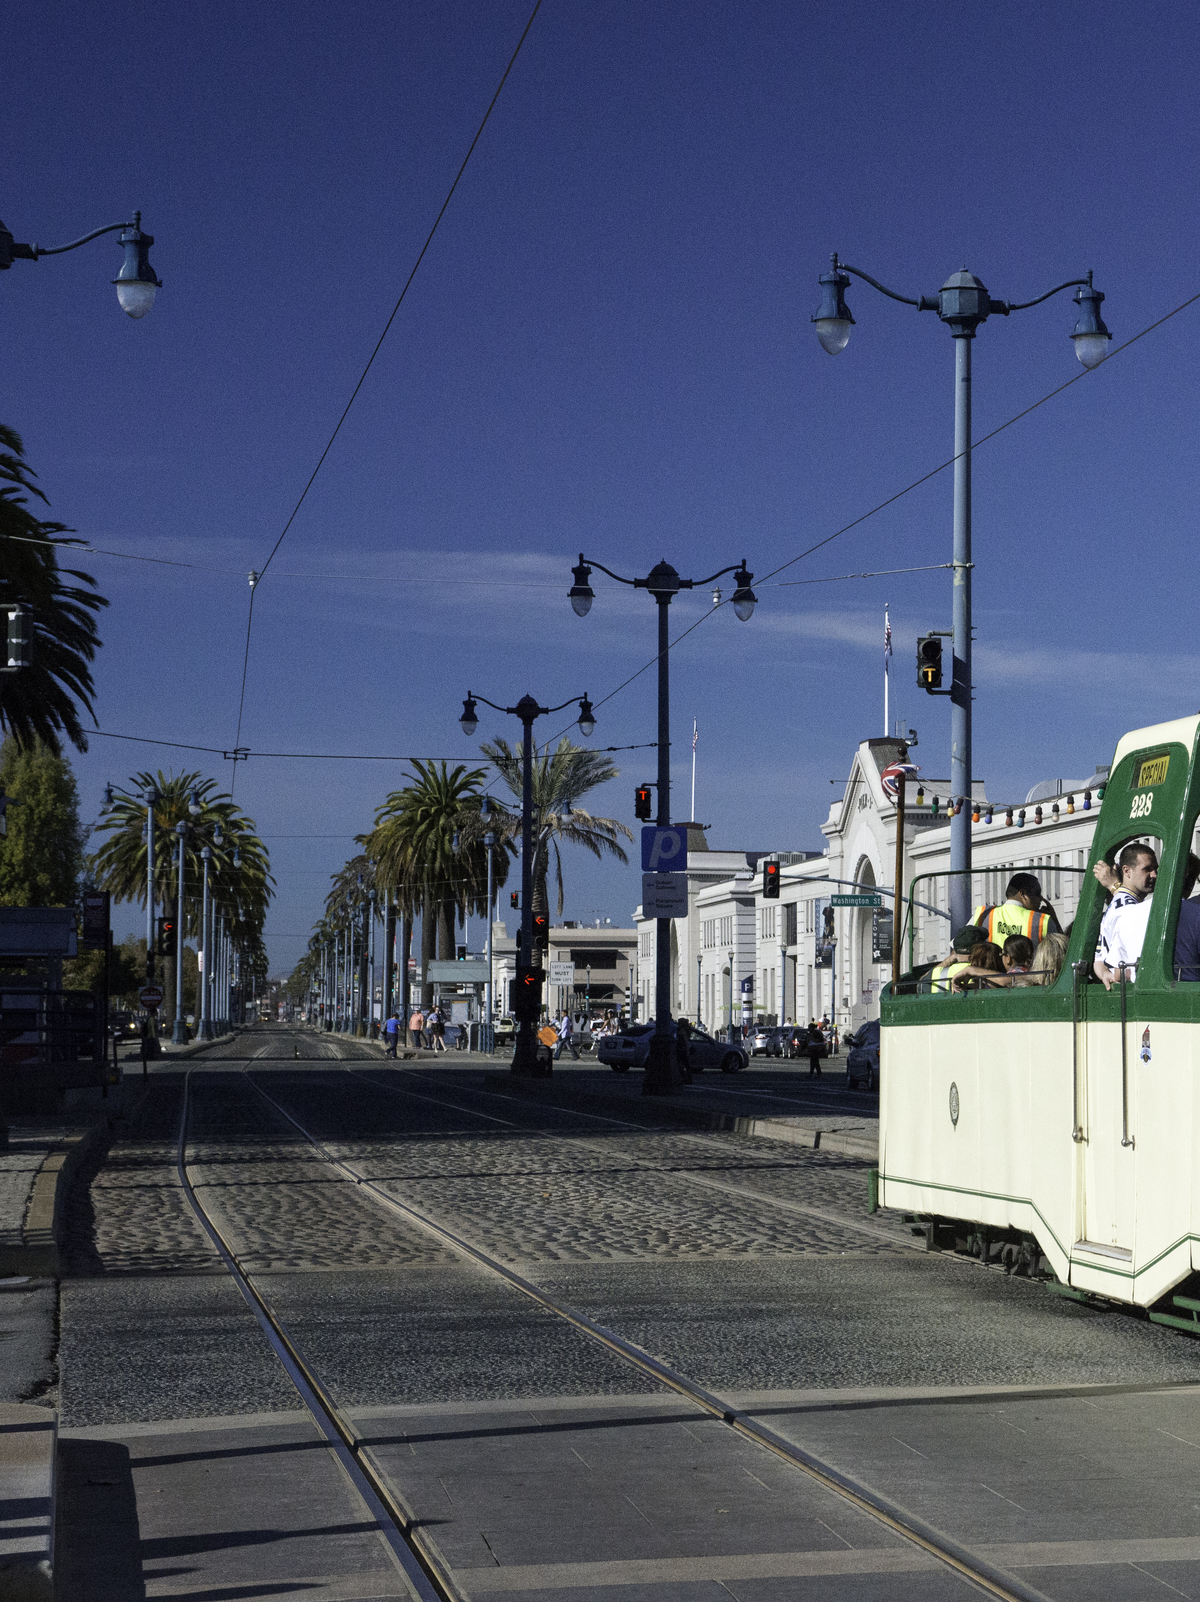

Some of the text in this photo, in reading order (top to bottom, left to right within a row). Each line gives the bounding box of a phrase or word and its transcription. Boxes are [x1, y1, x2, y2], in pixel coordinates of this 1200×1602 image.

[1129, 791, 1154, 819] 228
[832, 897, 881, 906] Washington St
[744, 982, 751, 992] P
